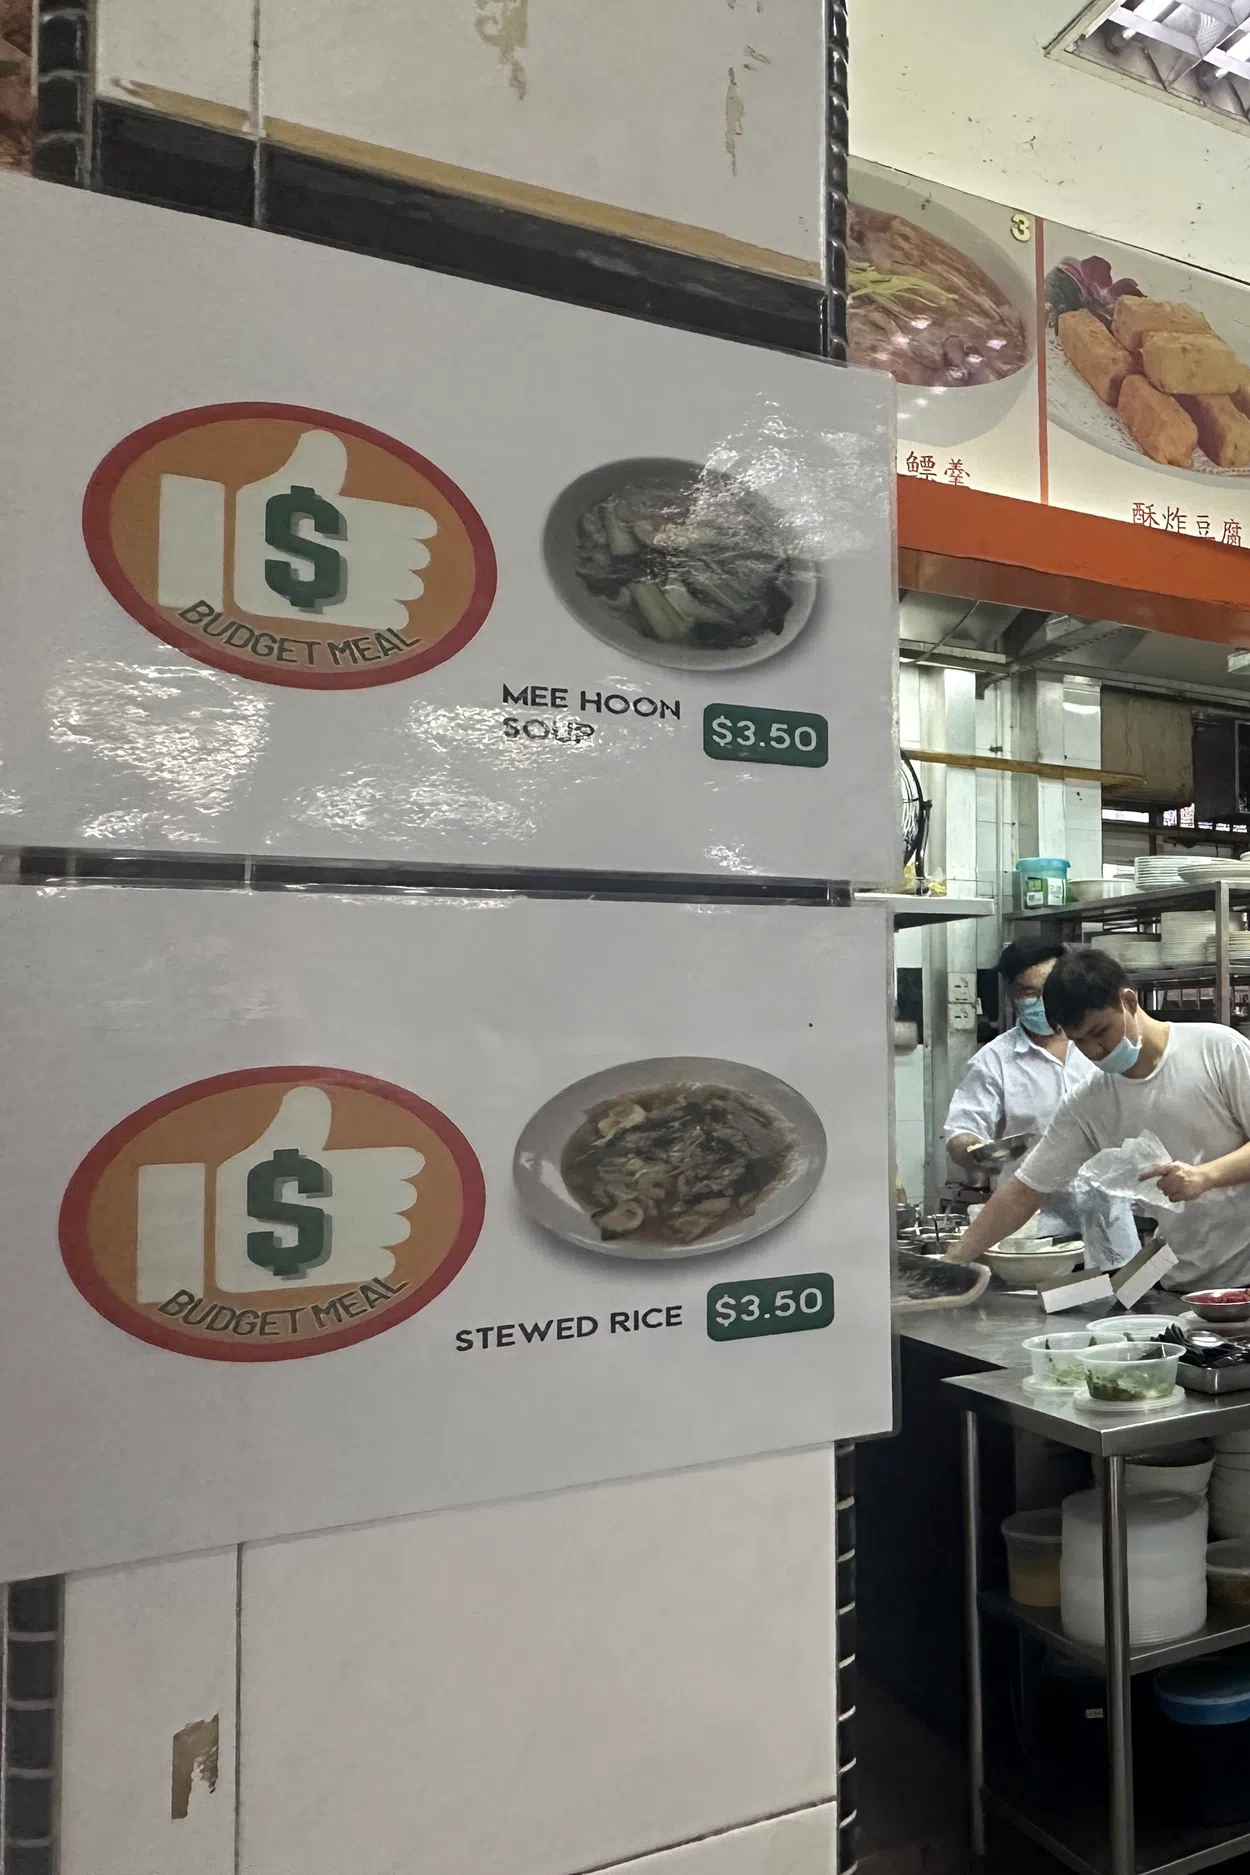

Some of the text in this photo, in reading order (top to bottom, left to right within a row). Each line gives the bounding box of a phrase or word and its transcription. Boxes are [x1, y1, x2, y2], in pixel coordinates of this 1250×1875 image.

[1011, 213, 1030, 242] 3
[1132, 502, 1242, 547] 酥炸豆腐
[178, 599, 422, 666] BUDGET MEAL
[502, 684, 681, 720] MEE HOON
[502, 717, 596, 744] SOUP
[711, 715, 817, 752] $3.50
[157, 1277, 409, 1337] BUDGET MEAL
[714, 1287, 823, 1327] $3.50
[455, 1305, 683, 1352] STEWED RICE
